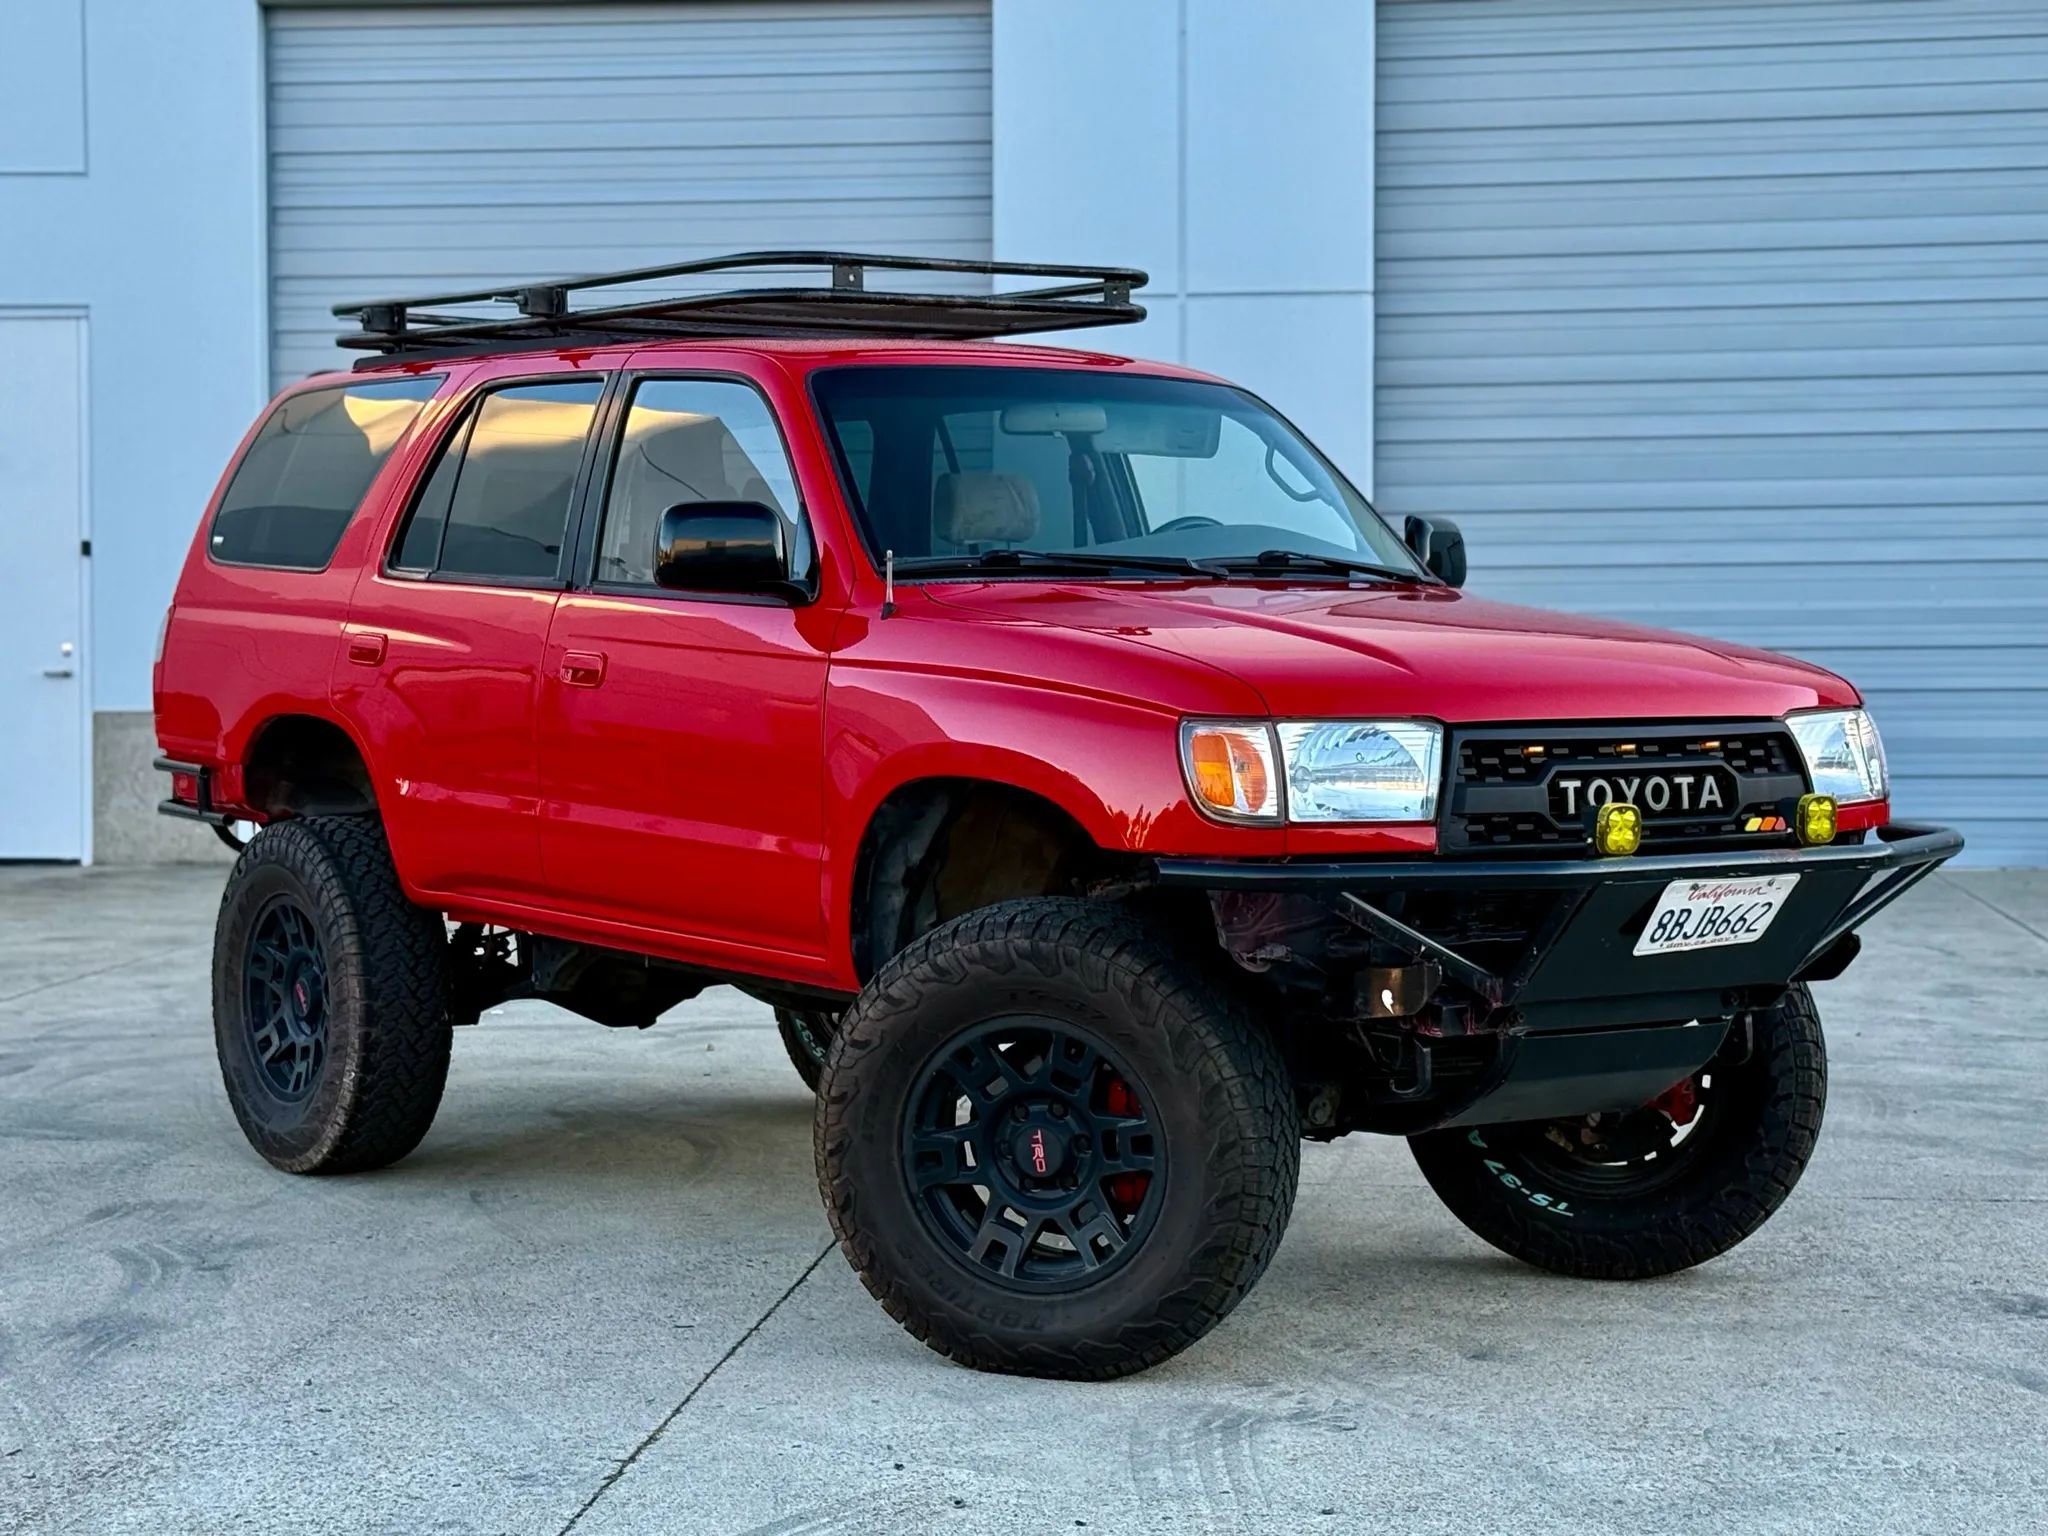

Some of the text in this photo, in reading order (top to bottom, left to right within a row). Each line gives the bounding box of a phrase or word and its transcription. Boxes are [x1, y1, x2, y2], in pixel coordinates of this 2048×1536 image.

[1560, 775, 1723, 814] TOYOTA
[1688, 883, 1766, 904] California
[1650, 902, 1773, 943] 8BJB662
